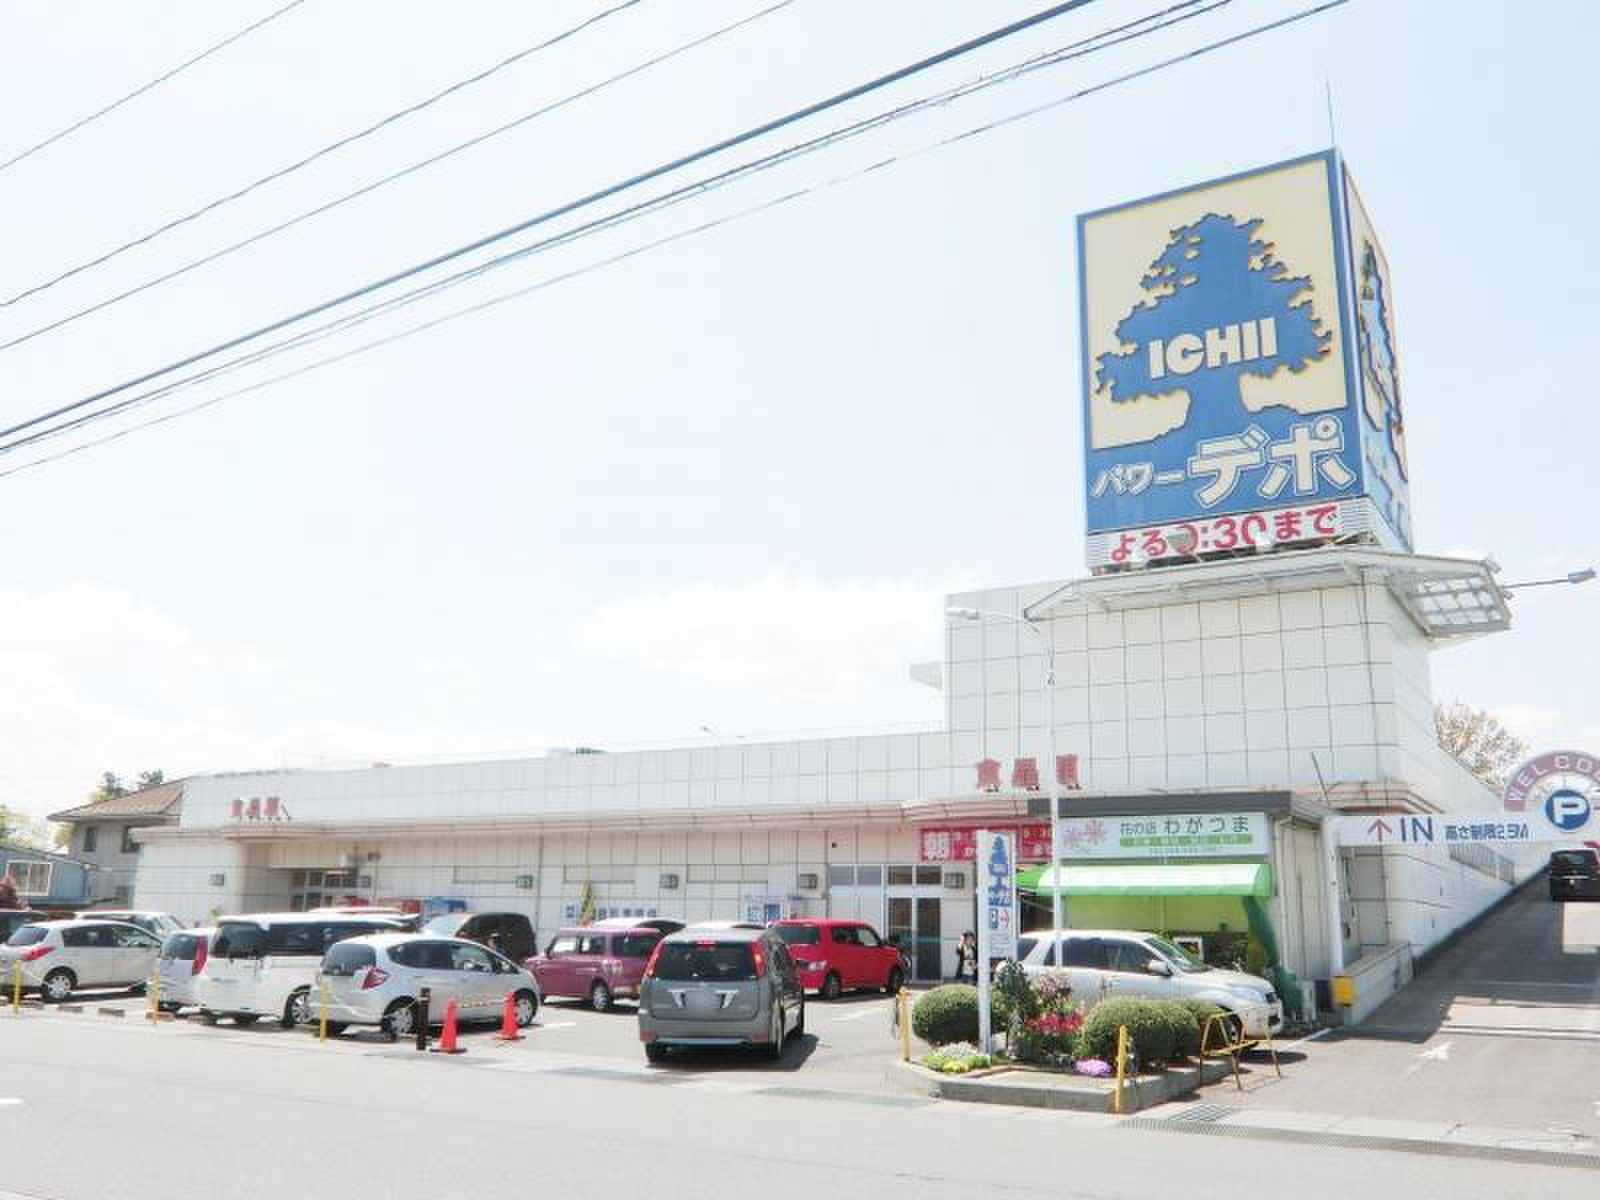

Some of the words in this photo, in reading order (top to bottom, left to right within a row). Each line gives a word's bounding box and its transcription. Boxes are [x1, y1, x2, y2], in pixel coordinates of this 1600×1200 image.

[1150, 317, 1278, 380] ICHII
[1093, 415, 1357, 507] パワーデポ
[1508, 755, 1600, 801] WELCO
[1164, 815, 1249, 835] わがつま
[1400, 816, 1434, 842] IN
